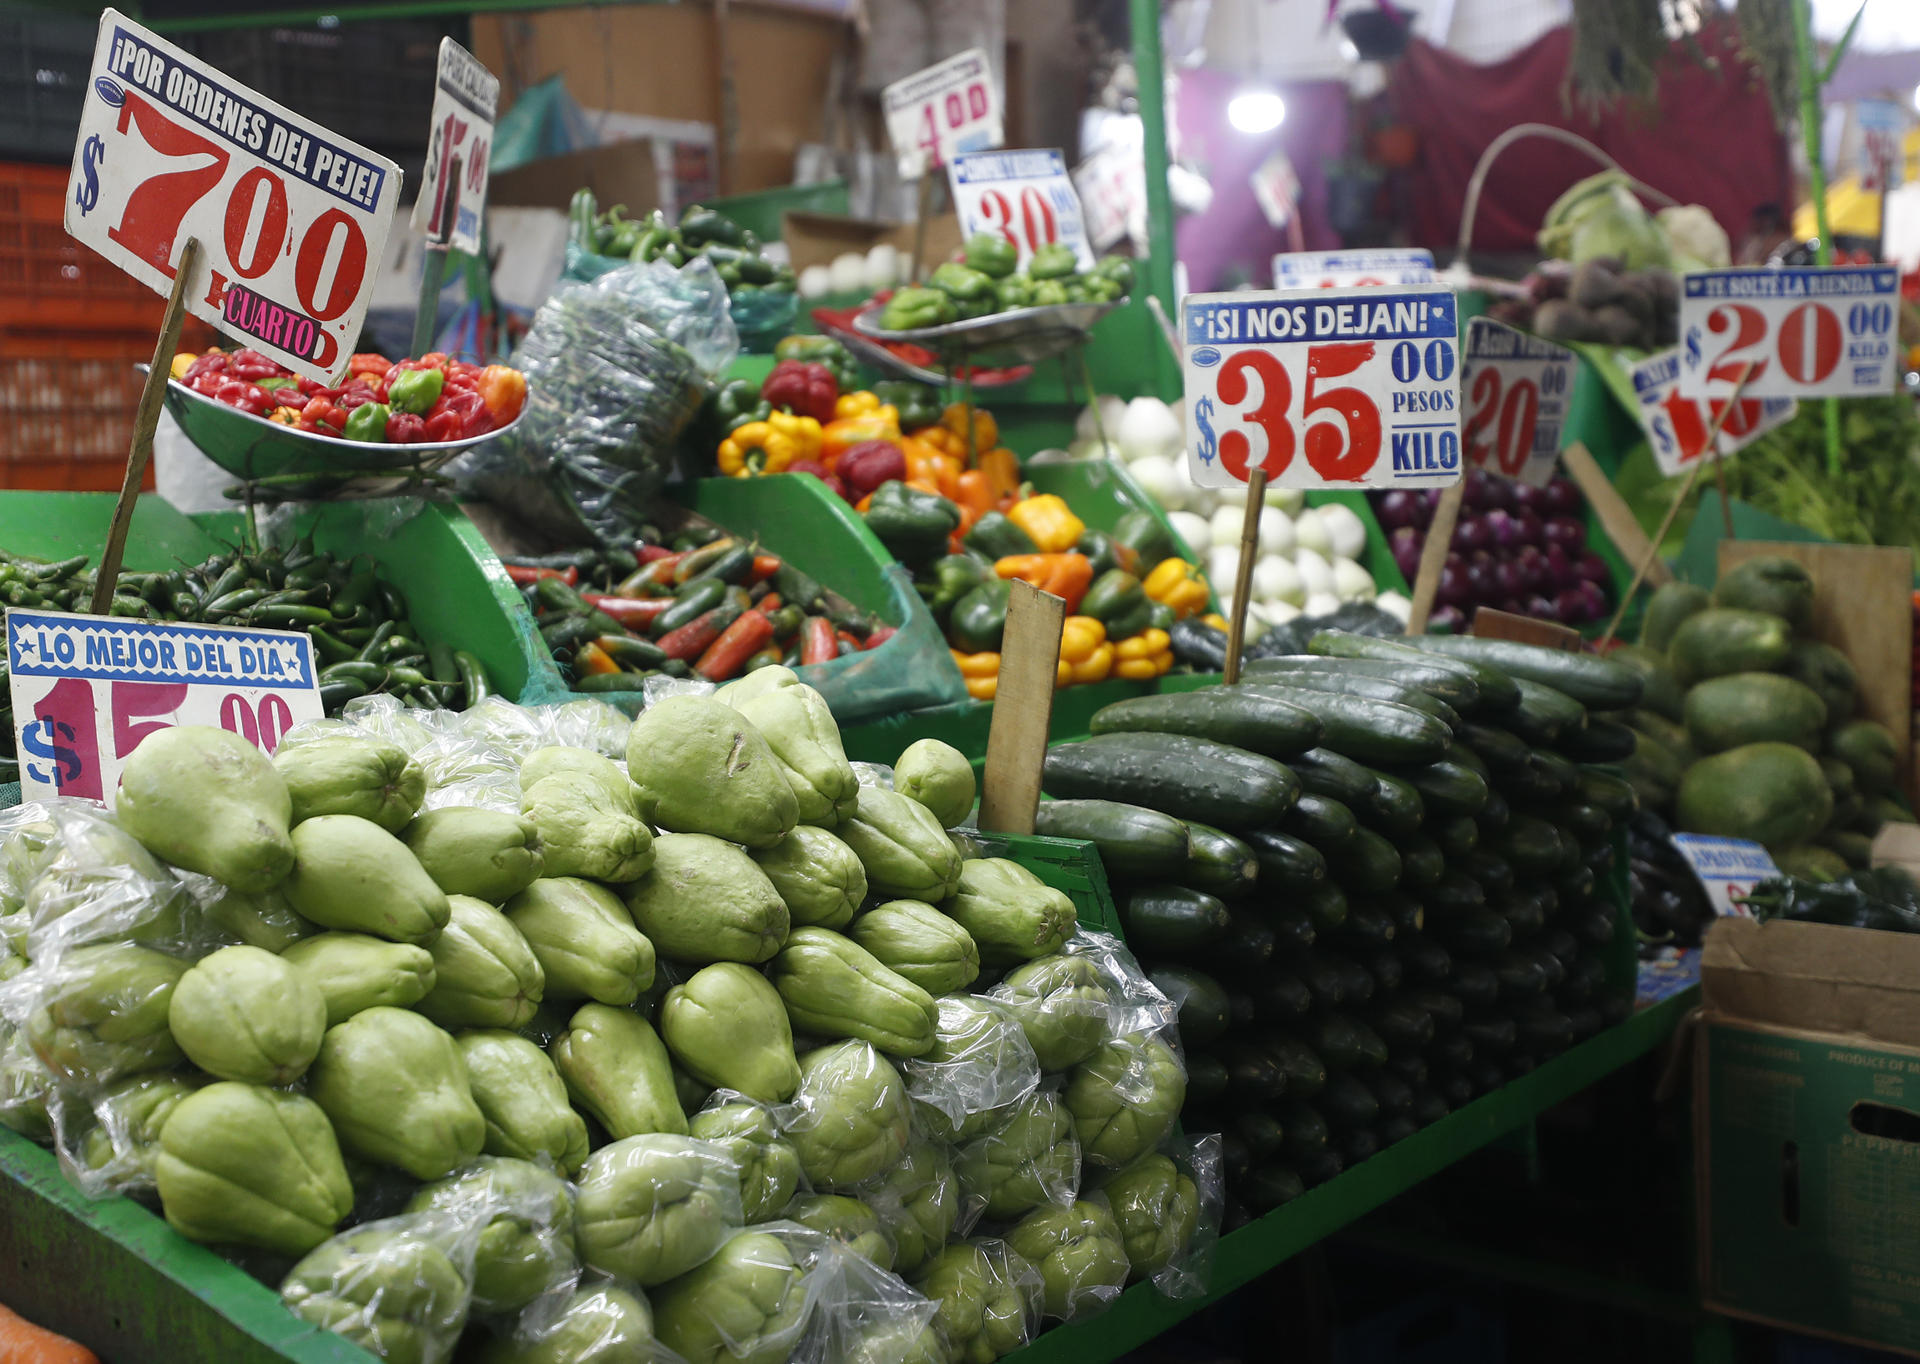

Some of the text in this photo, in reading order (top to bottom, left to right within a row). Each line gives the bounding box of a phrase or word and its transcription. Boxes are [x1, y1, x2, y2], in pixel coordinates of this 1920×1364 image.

[111, 37, 380, 207] ¡POR ORDENES DEL PEJE!
[225, 285, 314, 357] CUARTO
[1207, 301, 1428, 339] ¡SI NOS DEJAN!
[1848, 302, 1893, 336] 00
[1391, 338, 1455, 384] 00
[1391, 389, 1455, 413] PESOS
[1391, 430, 1459, 472] KILO
[37, 631, 286, 676] LO MEJOR DEL DIA
[1828, 1050, 1886, 1069] PRODUCE
[1887, 1059, 1905, 1071] OF
